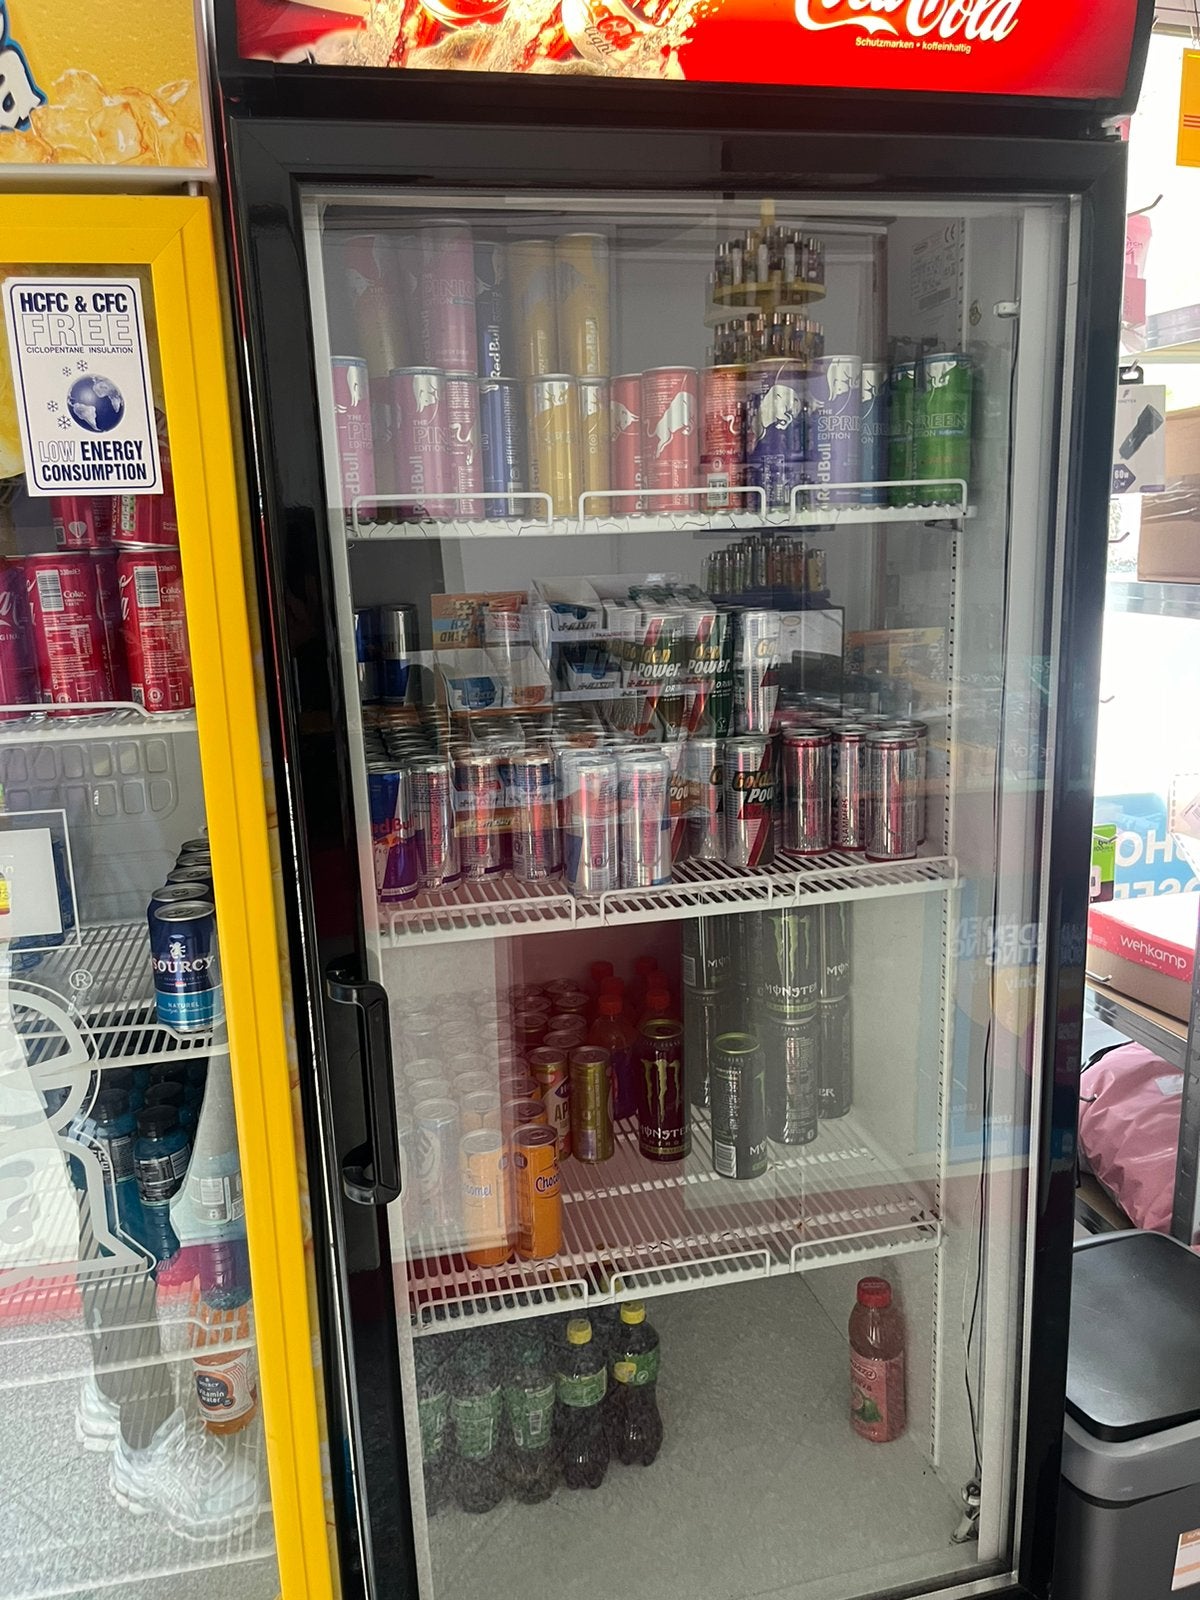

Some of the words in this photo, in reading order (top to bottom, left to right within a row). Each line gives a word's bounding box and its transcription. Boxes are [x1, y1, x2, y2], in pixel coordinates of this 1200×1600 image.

[855, 36, 914, 49] Schutzmarken
[20, 292, 69, 313] HCFC
[74, 295, 88, 313] &
[92, 292, 128, 313] CFC
[21, 313, 133, 347] FREE
[26, 346, 84, 354] CICLOPENTANE
[88, 346, 134, 354] INSULATION
[38, 440, 75, 463] LOW
[80, 440, 143, 461] ENERGY
[42, 463, 147, 482] CONSUMPTION
[637, 662, 681, 679] Power
[688, 659, 730, 675] Power
[1119, 934, 1187, 970] wehkamp
[152, 955, 215, 974] SOURCY
